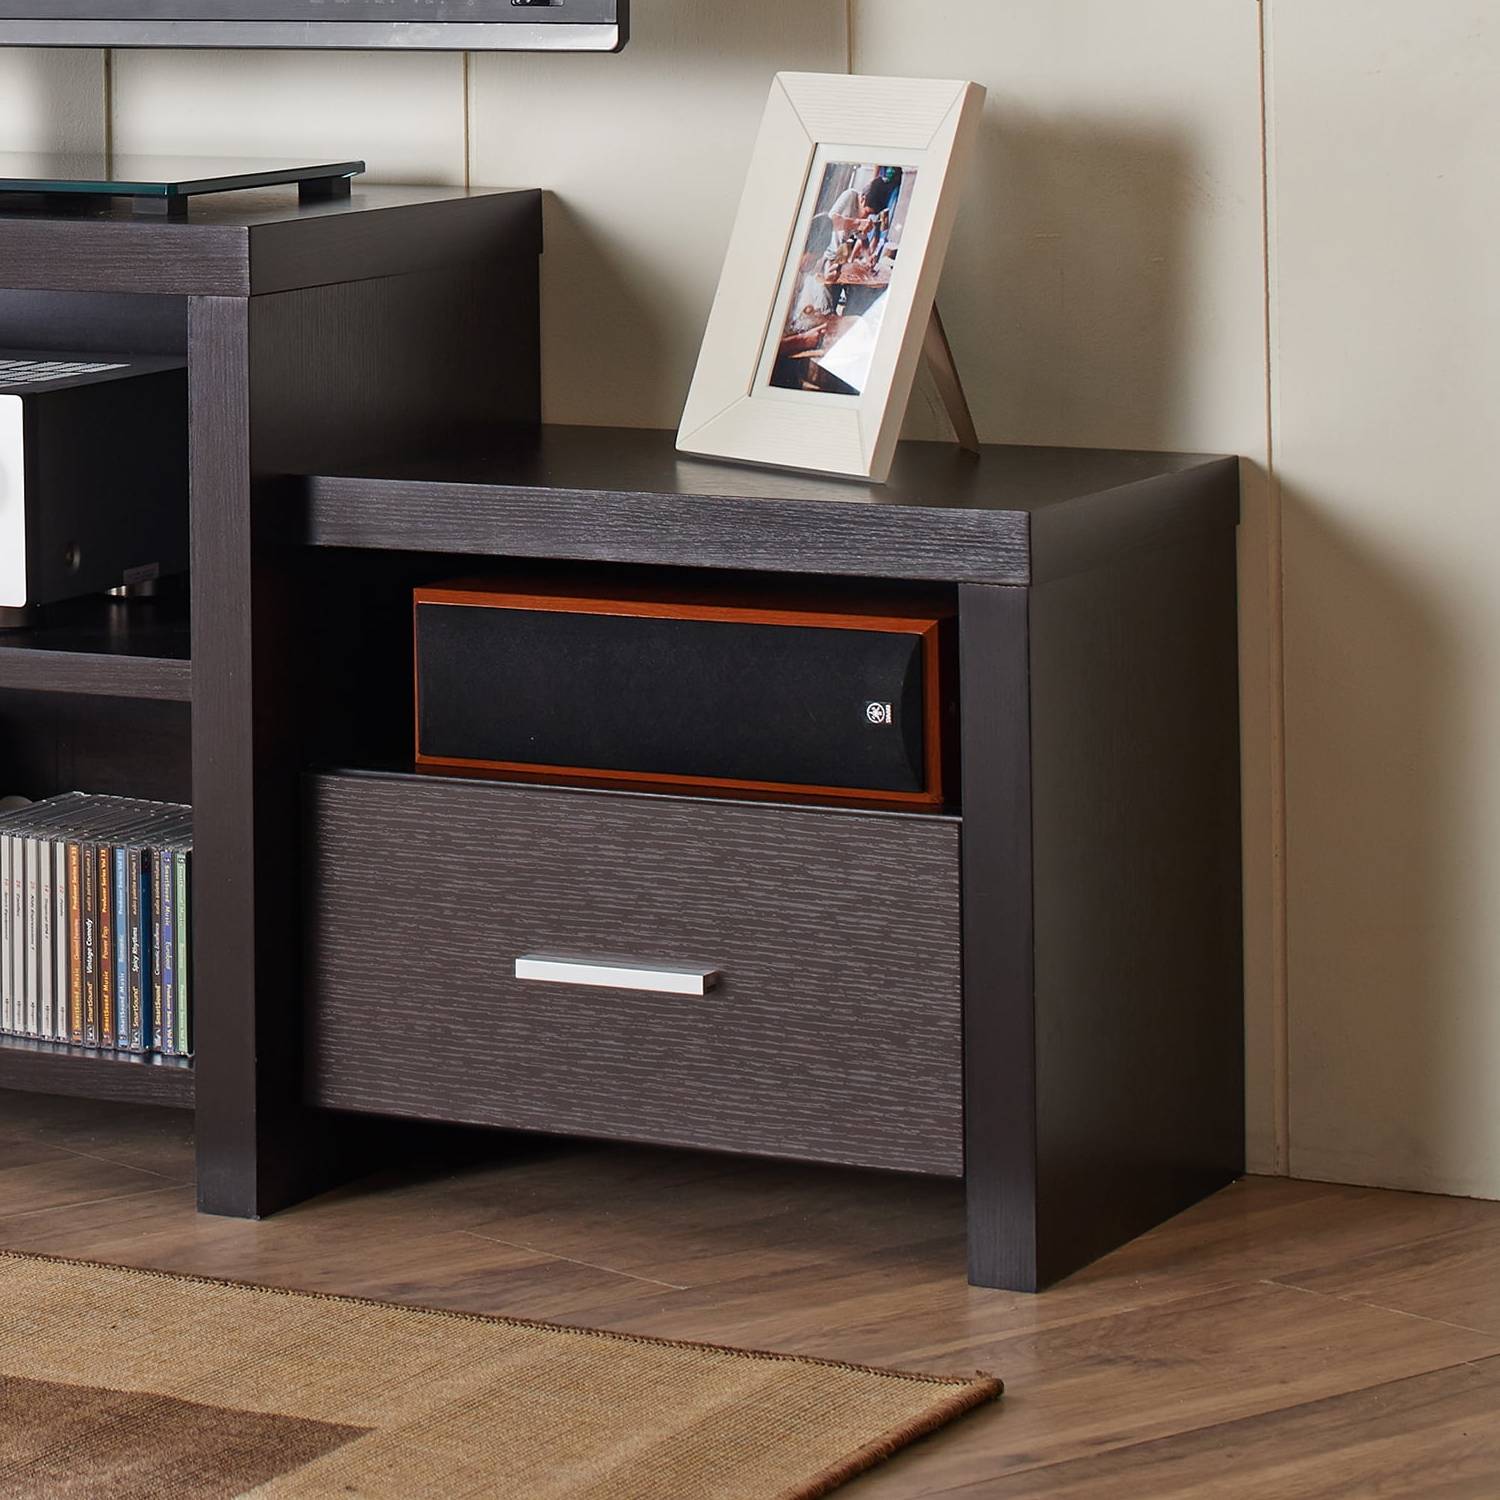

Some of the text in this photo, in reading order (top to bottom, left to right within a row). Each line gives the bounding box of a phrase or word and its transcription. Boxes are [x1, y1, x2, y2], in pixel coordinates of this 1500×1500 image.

[85, 918, 94, 947] Comedy
[101, 925, 109, 939] Pop
[131, 927, 139, 955] Rhythms
[86, 947, 94, 974] Vintage
[101, 940, 109, 959] Power
[131, 956, 140, 972] Spicy
